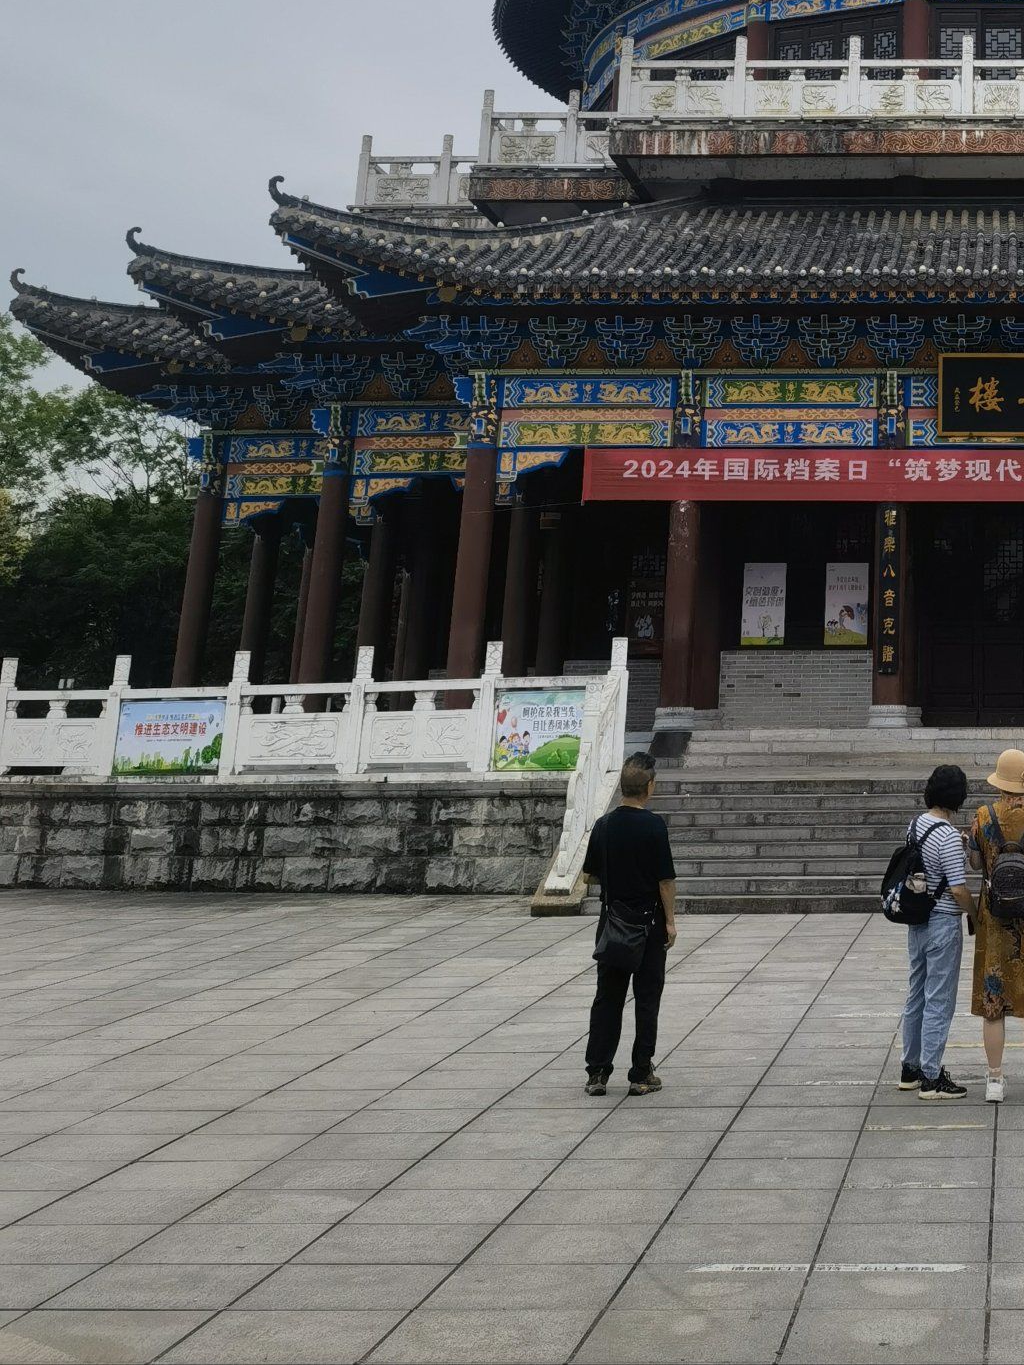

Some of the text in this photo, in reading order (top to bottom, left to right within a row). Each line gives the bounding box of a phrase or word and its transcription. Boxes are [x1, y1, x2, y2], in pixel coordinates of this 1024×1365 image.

[622, 457, 869, 481] 2024年国际档案日
[522, 707, 575, 718] 呵护花朵我当先
[134, 722, 207, 736] 推进生态文明建设
